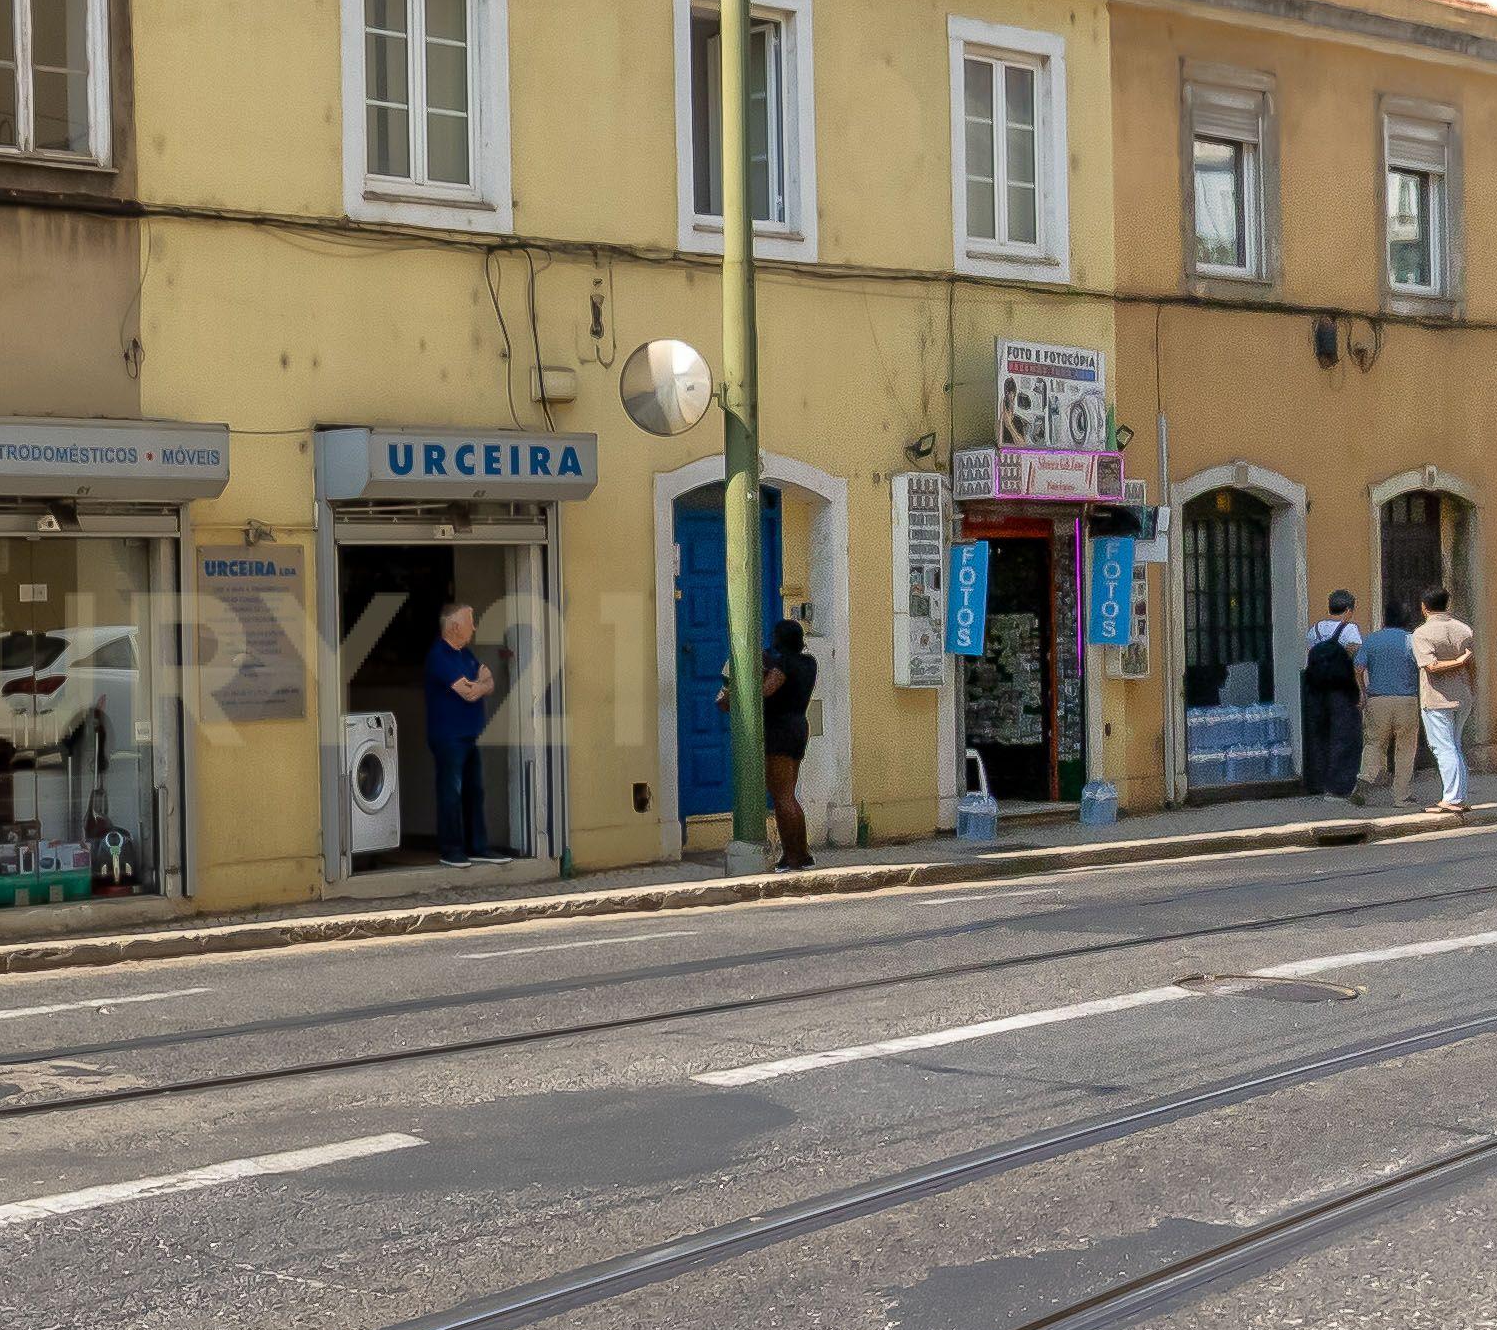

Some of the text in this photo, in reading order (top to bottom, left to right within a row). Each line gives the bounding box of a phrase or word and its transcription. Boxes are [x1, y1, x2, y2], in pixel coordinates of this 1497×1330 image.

[1007, 346, 1032, 361] FOTO
[161, 445, 221, 467] MÓVEIS
[388, 444, 583, 476] URCEIRA
[204, 560, 276, 577] URCEIRA
[957, 547, 975, 647] FOTOS
[1101, 540, 1121, 638] FOTOS
